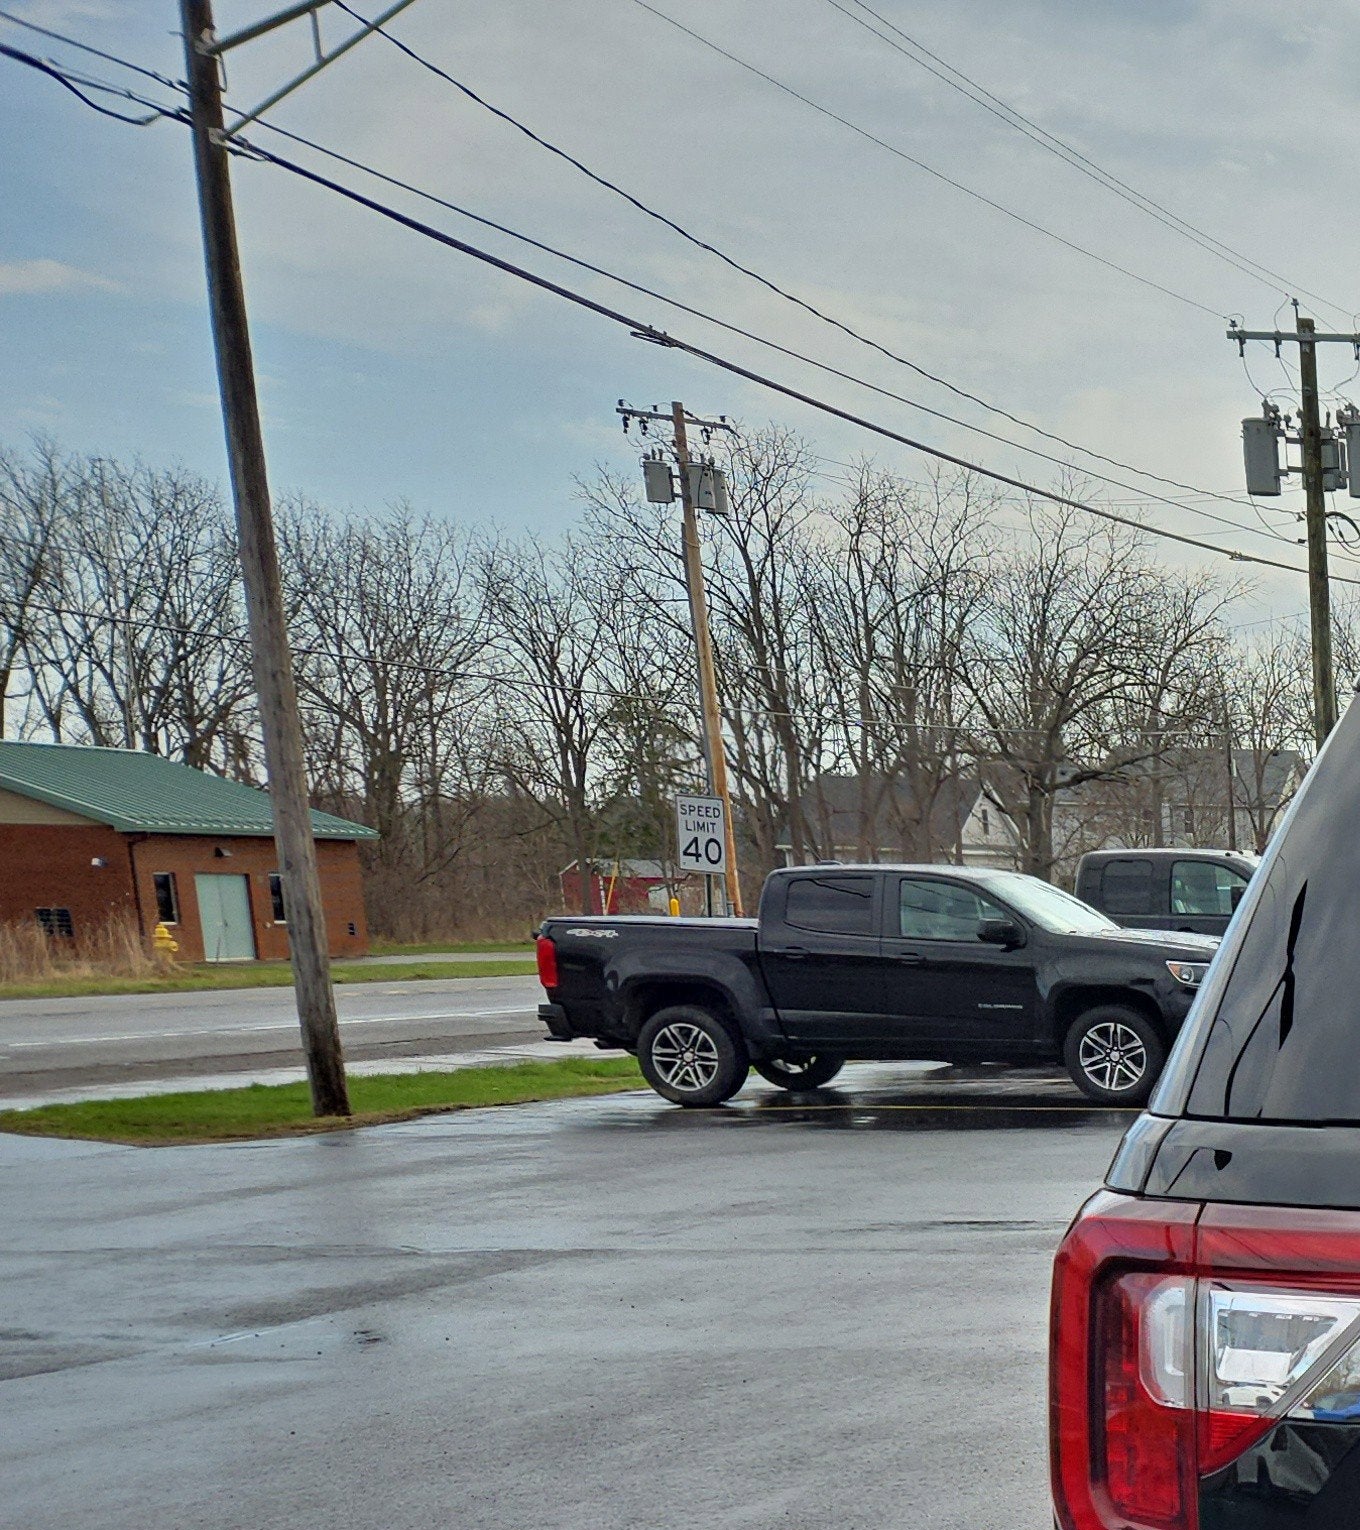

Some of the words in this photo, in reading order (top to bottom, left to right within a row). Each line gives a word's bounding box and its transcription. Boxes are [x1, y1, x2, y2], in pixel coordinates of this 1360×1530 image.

[680, 803, 721, 819] SPEED
[685, 819, 717, 834] LIMIT
[682, 836, 722, 865] 40
